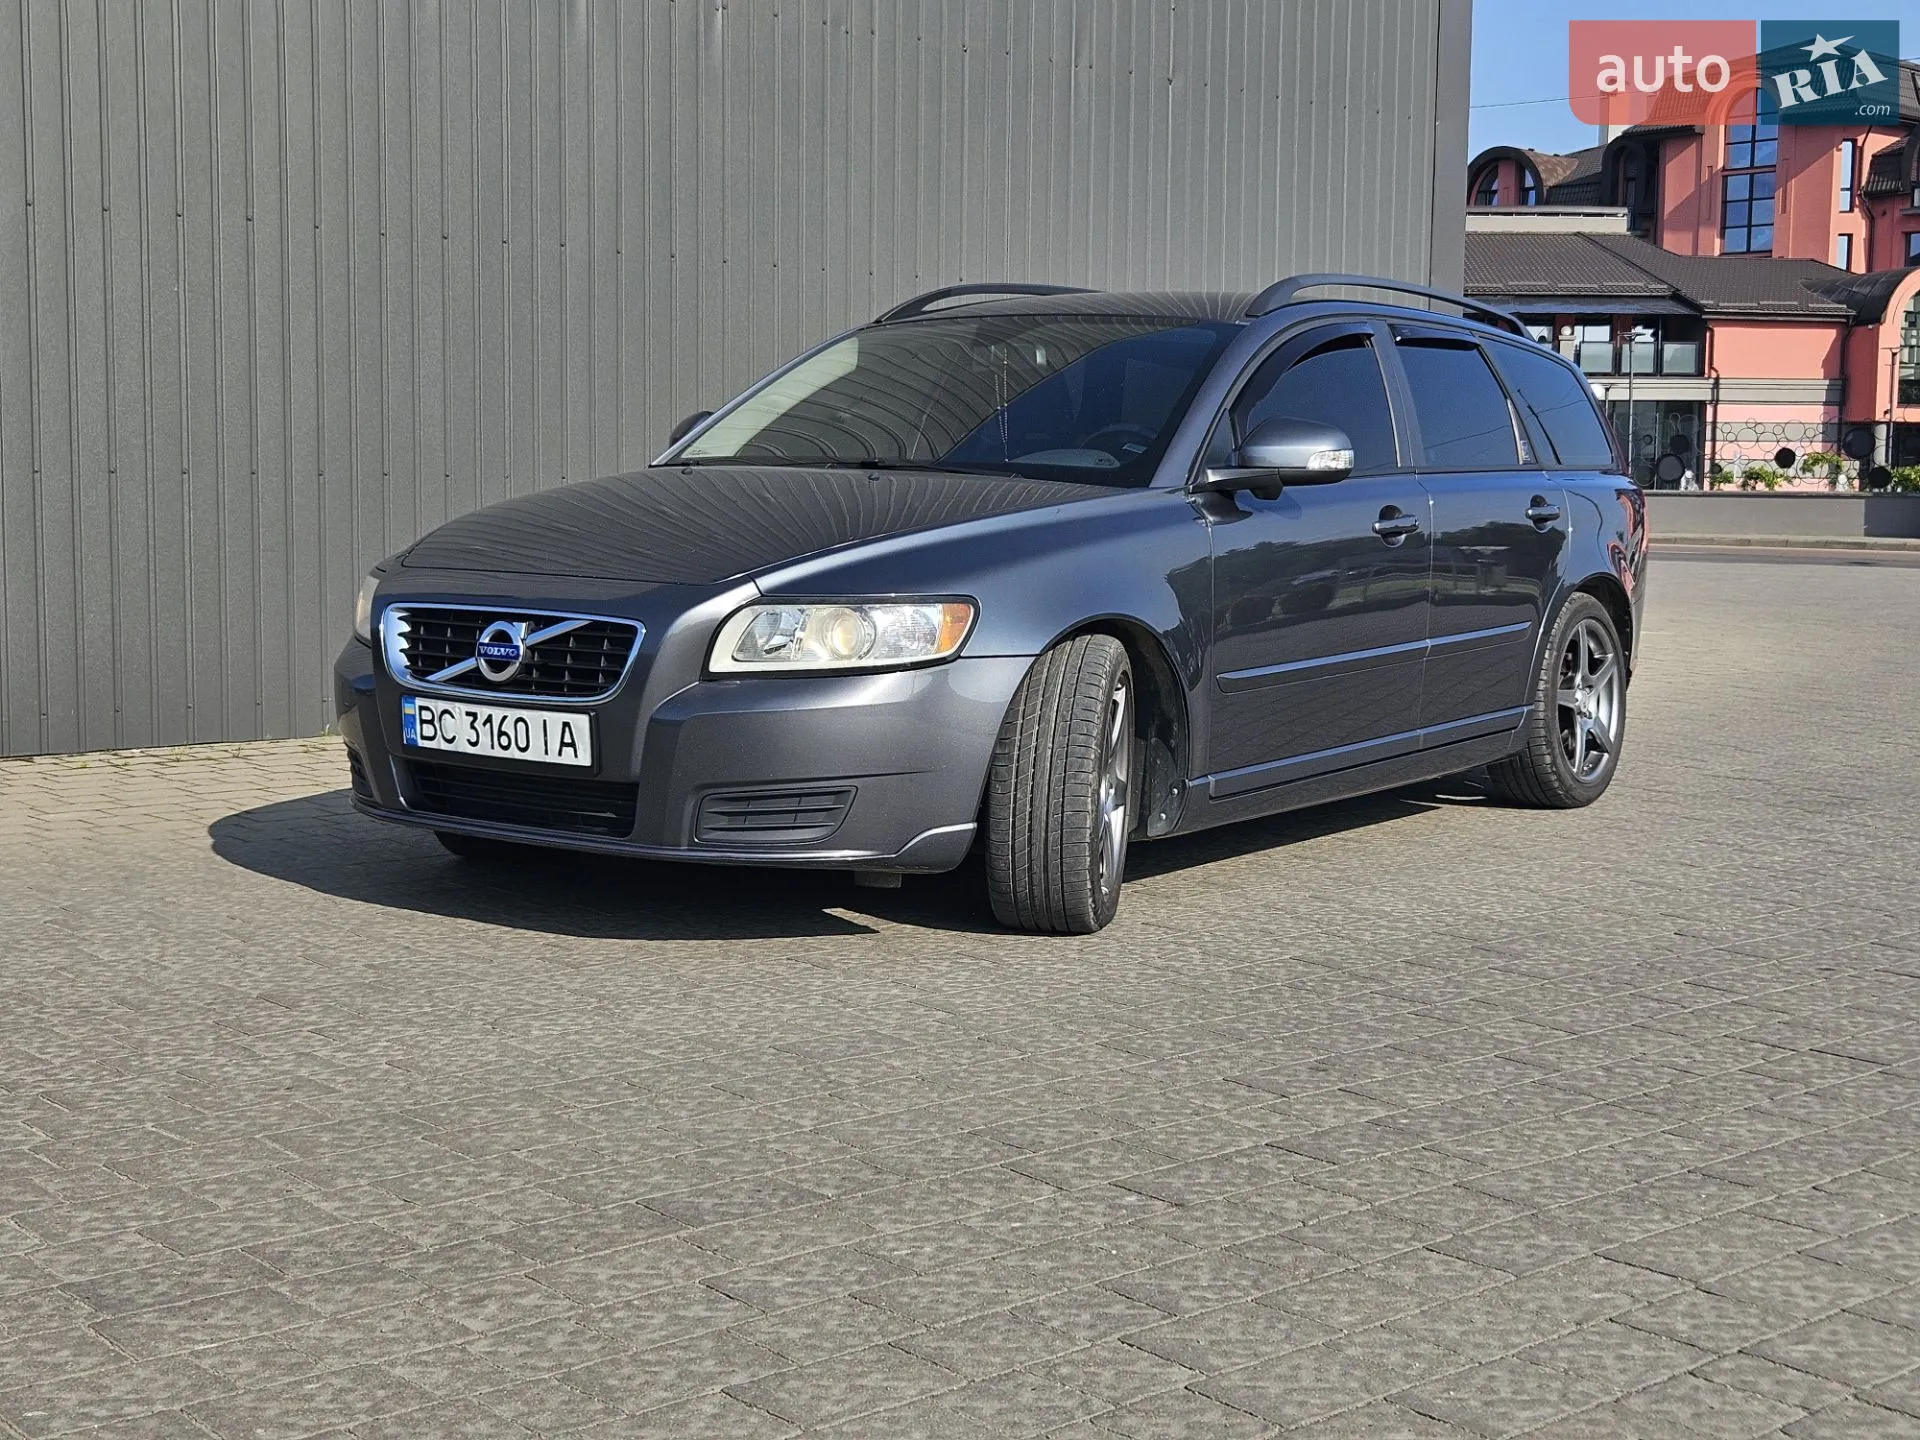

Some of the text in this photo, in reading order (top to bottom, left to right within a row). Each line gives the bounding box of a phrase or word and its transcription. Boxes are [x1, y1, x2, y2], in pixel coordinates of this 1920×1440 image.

[478, 645, 518, 657] VOLVO
[404, 727, 417, 740] UA
[418, 705, 578, 759] BC 3160 IA
